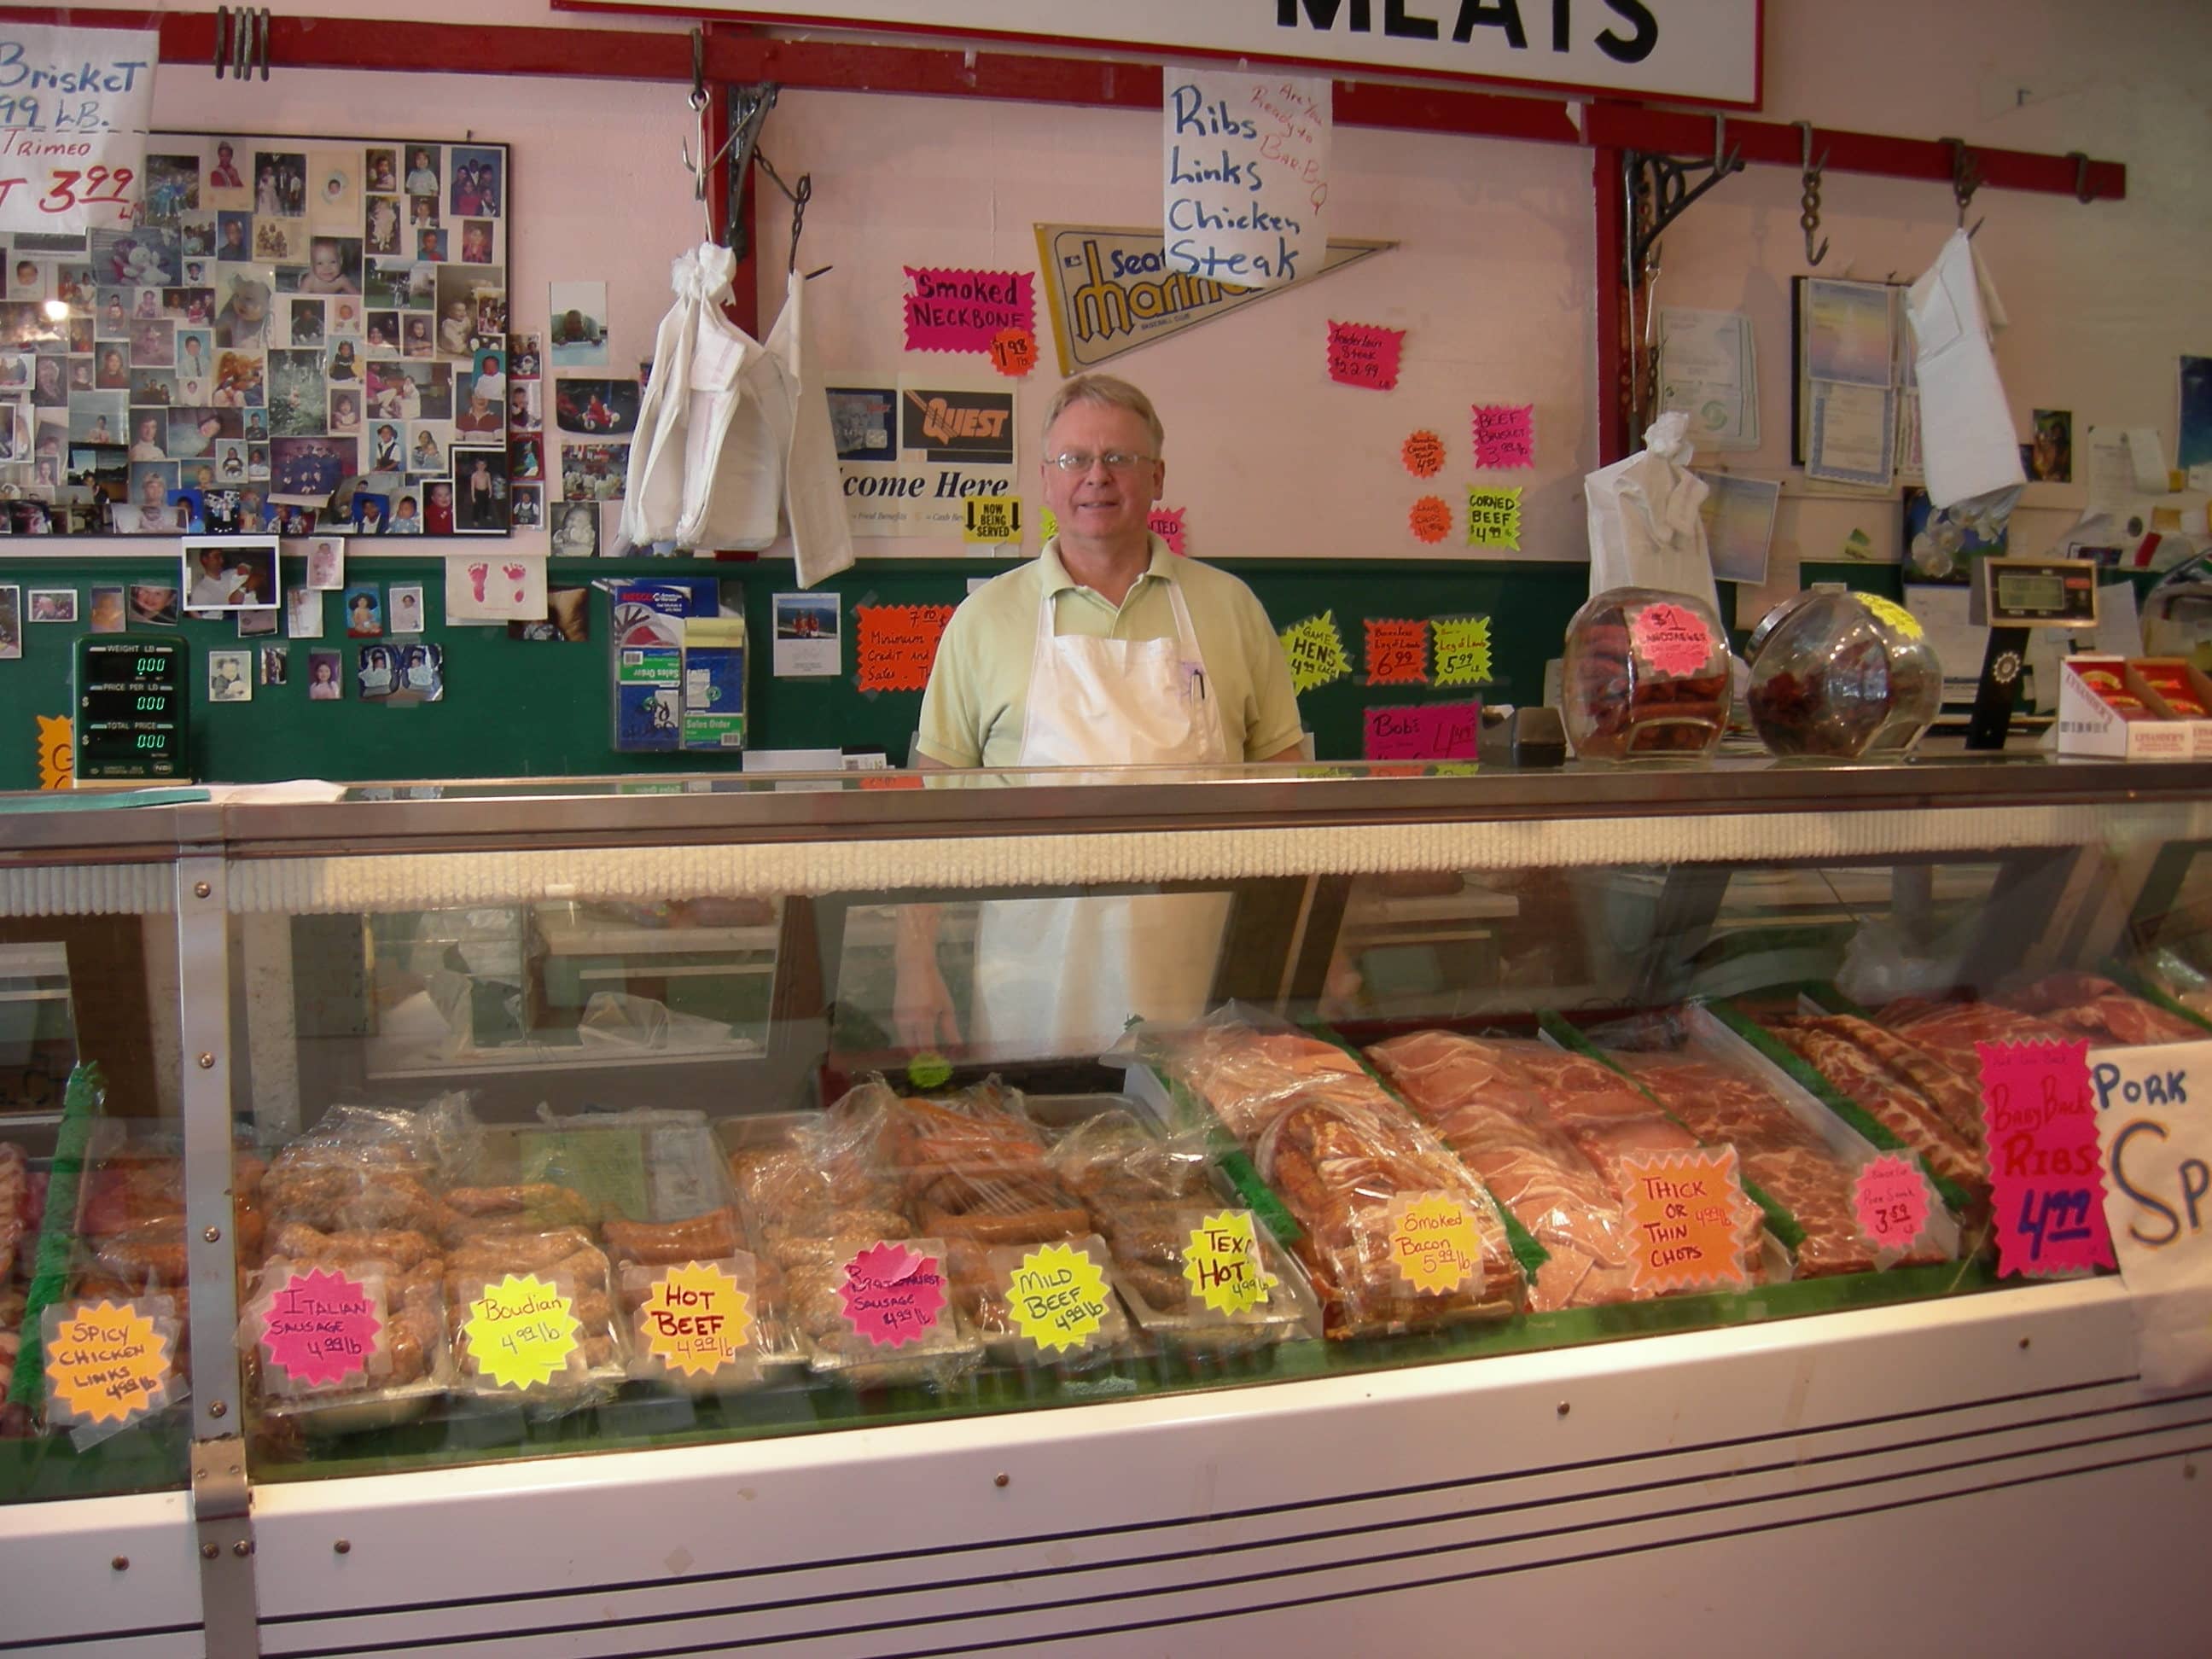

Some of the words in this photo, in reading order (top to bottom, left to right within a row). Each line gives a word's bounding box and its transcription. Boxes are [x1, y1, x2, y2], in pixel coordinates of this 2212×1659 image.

[1170, 84, 1257, 139] Ribs
[1170, 146, 1262, 191] Links
[1169, 199, 1301, 235] Chicken
[1170, 237, 1299, 280] Steak
[919, 274, 1017, 306] Smoked
[912, 302, 1025, 329] NECKBONE
[923, 398, 1009, 445] QUEST
[1478, 410, 1522, 428] BEEF
[840, 469, 925, 498] come
[934, 471, 1009, 498] Here
[983, 504, 1004, 513] NOW
[1470, 495, 1515, 510] CORNED
[981, 514, 1007, 526] BEING
[1472, 510, 1511, 526] BEEF
[976, 526, 1010, 538] SERVED
[1293, 637, 1336, 667] HENS
[686, 719, 708, 729] Sales
[709, 719, 731, 729] Order
[2093, 1062, 2186, 1109] PORK
[2002, 1132, 2093, 1178] RIBS
[1640, 1176, 1707, 1201] THICK
[1404, 1209, 1463, 1231] Smoked
[1665, 1203, 1687, 1220] OR
[1643, 1222, 1687, 1243] THIN
[1394, 1237, 1451, 1256] Bacon
[1650, 1245, 1703, 1267] CHOPS
[1020, 1268, 1073, 1294] MILD
[1198, 1258, 1245, 1291] HOT
[282, 1289, 367, 1316] ITALIAN
[477, 1294, 562, 1322] Boudian
[666, 1284, 715, 1310] HOT
[854, 1295, 915, 1311] SAUSAGE
[1023, 1286, 1081, 1319] BEEF
[73, 1323, 129, 1346] SPICY
[271, 1320, 344, 1335] SAUSAGE
[650, 1311, 724, 1336] BEEF
[59, 1343, 145, 1365] CHICKEN
[73, 1365, 131, 1388] LINKS
